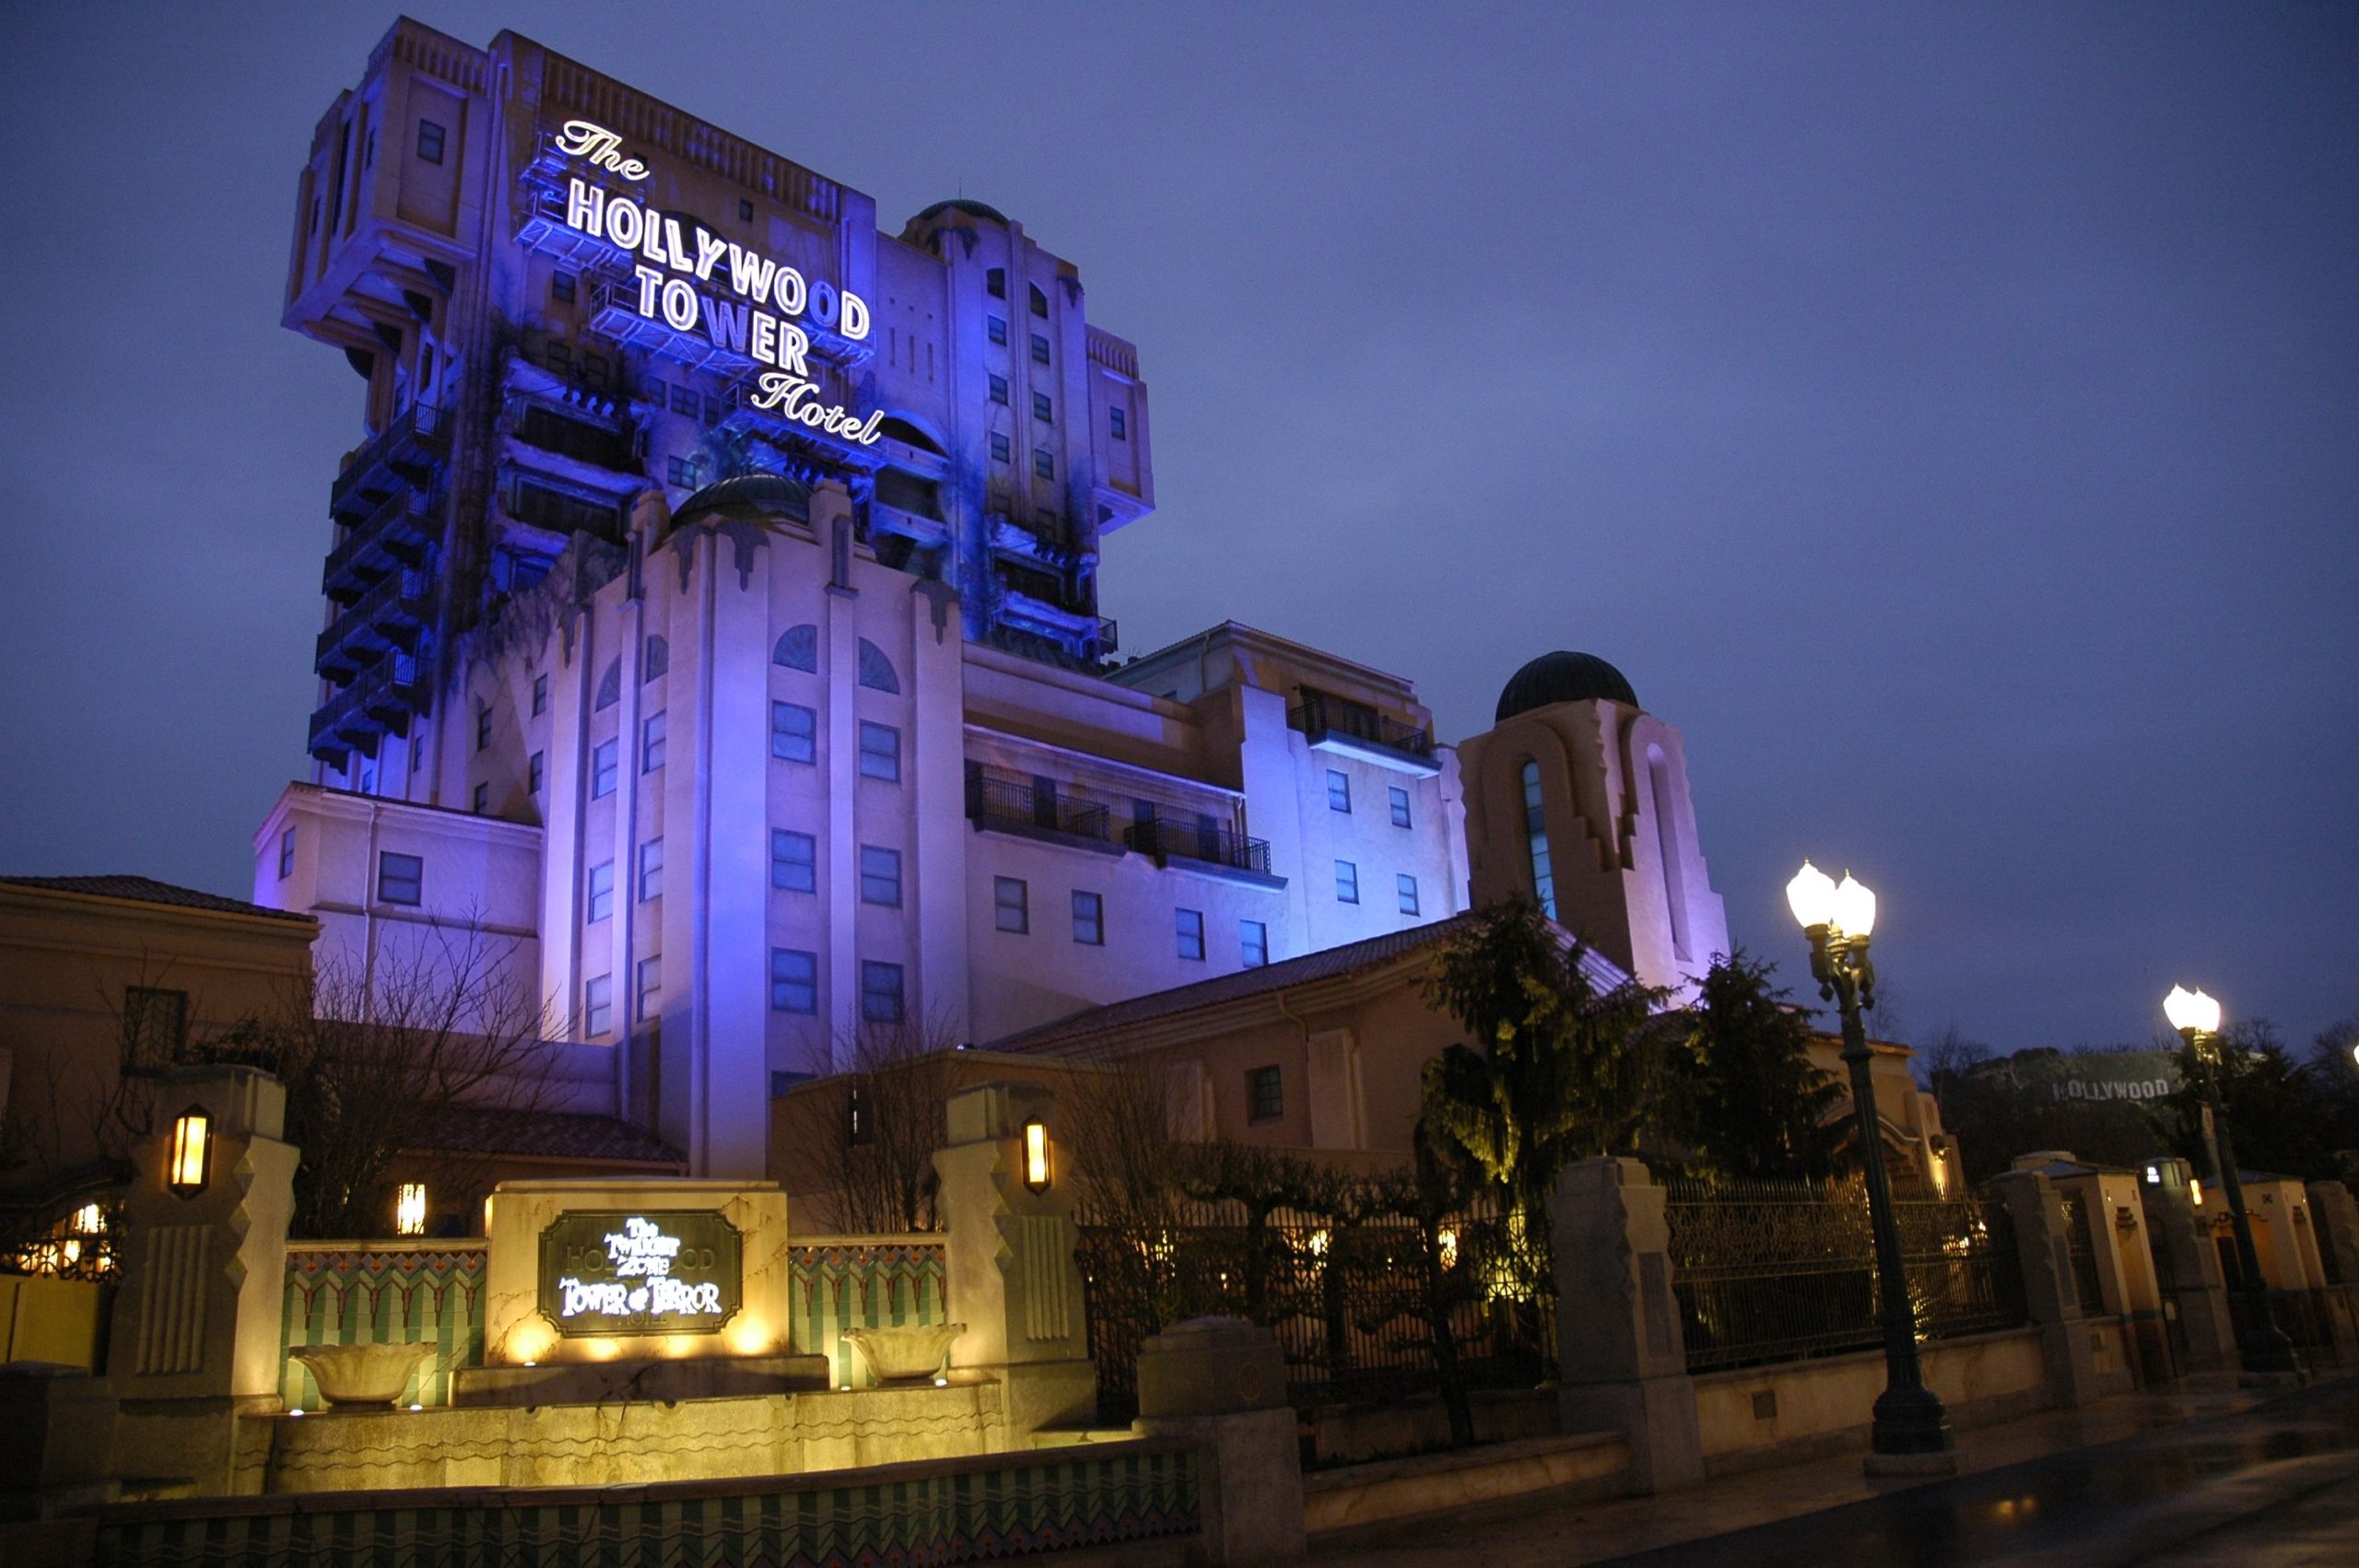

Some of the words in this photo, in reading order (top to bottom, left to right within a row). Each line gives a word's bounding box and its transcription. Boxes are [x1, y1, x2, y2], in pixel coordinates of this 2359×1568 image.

[555, 120, 651, 181] The
[566, 177, 871, 341] HOLLYWOOD
[634, 263, 810, 377] TOWER
[750, 371, 886, 446] Hotel
[2052, 1078, 2170, 1102] HOLLYWOOD
[559, 1277, 630, 1316] TOWER
[647, 1276, 722, 1315] TERROR
